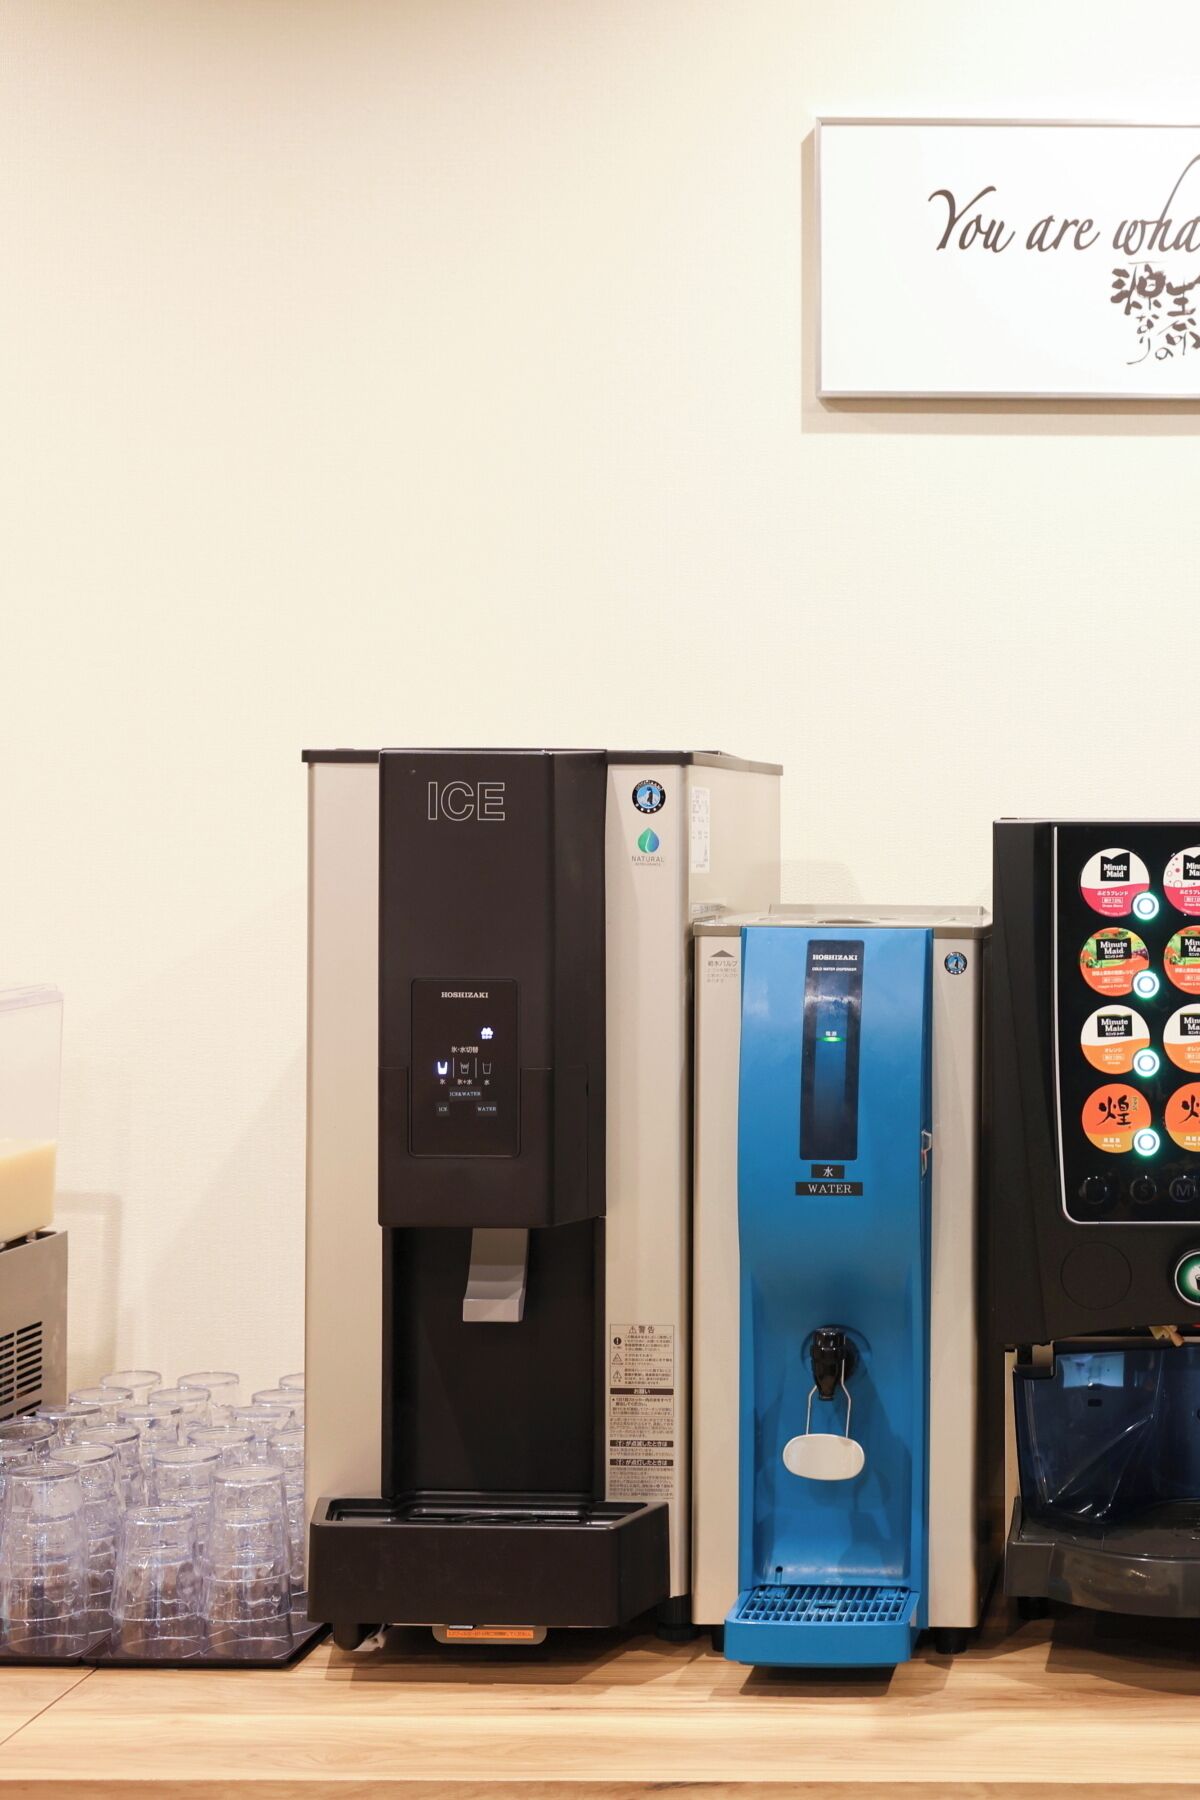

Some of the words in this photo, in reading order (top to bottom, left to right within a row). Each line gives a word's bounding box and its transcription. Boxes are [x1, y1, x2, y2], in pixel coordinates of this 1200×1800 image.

[927, 185, 1015, 253] You
[1025, 215, 1100, 253] are
[427, 781, 507, 822] ICE
[631, 855, 665, 863] NATURAL
[1103, 863, 1128, 872] Minute
[1106, 870, 1124, 878] Maid
[1100, 940, 1128, 949] Minute
[1104, 946, 1124, 955] Maid
[812, 954, 858, 962] HOSHIZAKI
[441, 991, 489, 999] HOSHIZAKI
[1101, 1018, 1129, 1026] Minute
[1105, 1024, 1125, 1032] Maid
[1097, 1094, 1131, 1126] 煌
[823, 1166, 834, 1178] 水
[808, 1183, 852, 1194] WATER
[1176, 1184, 1191, 1197] M
